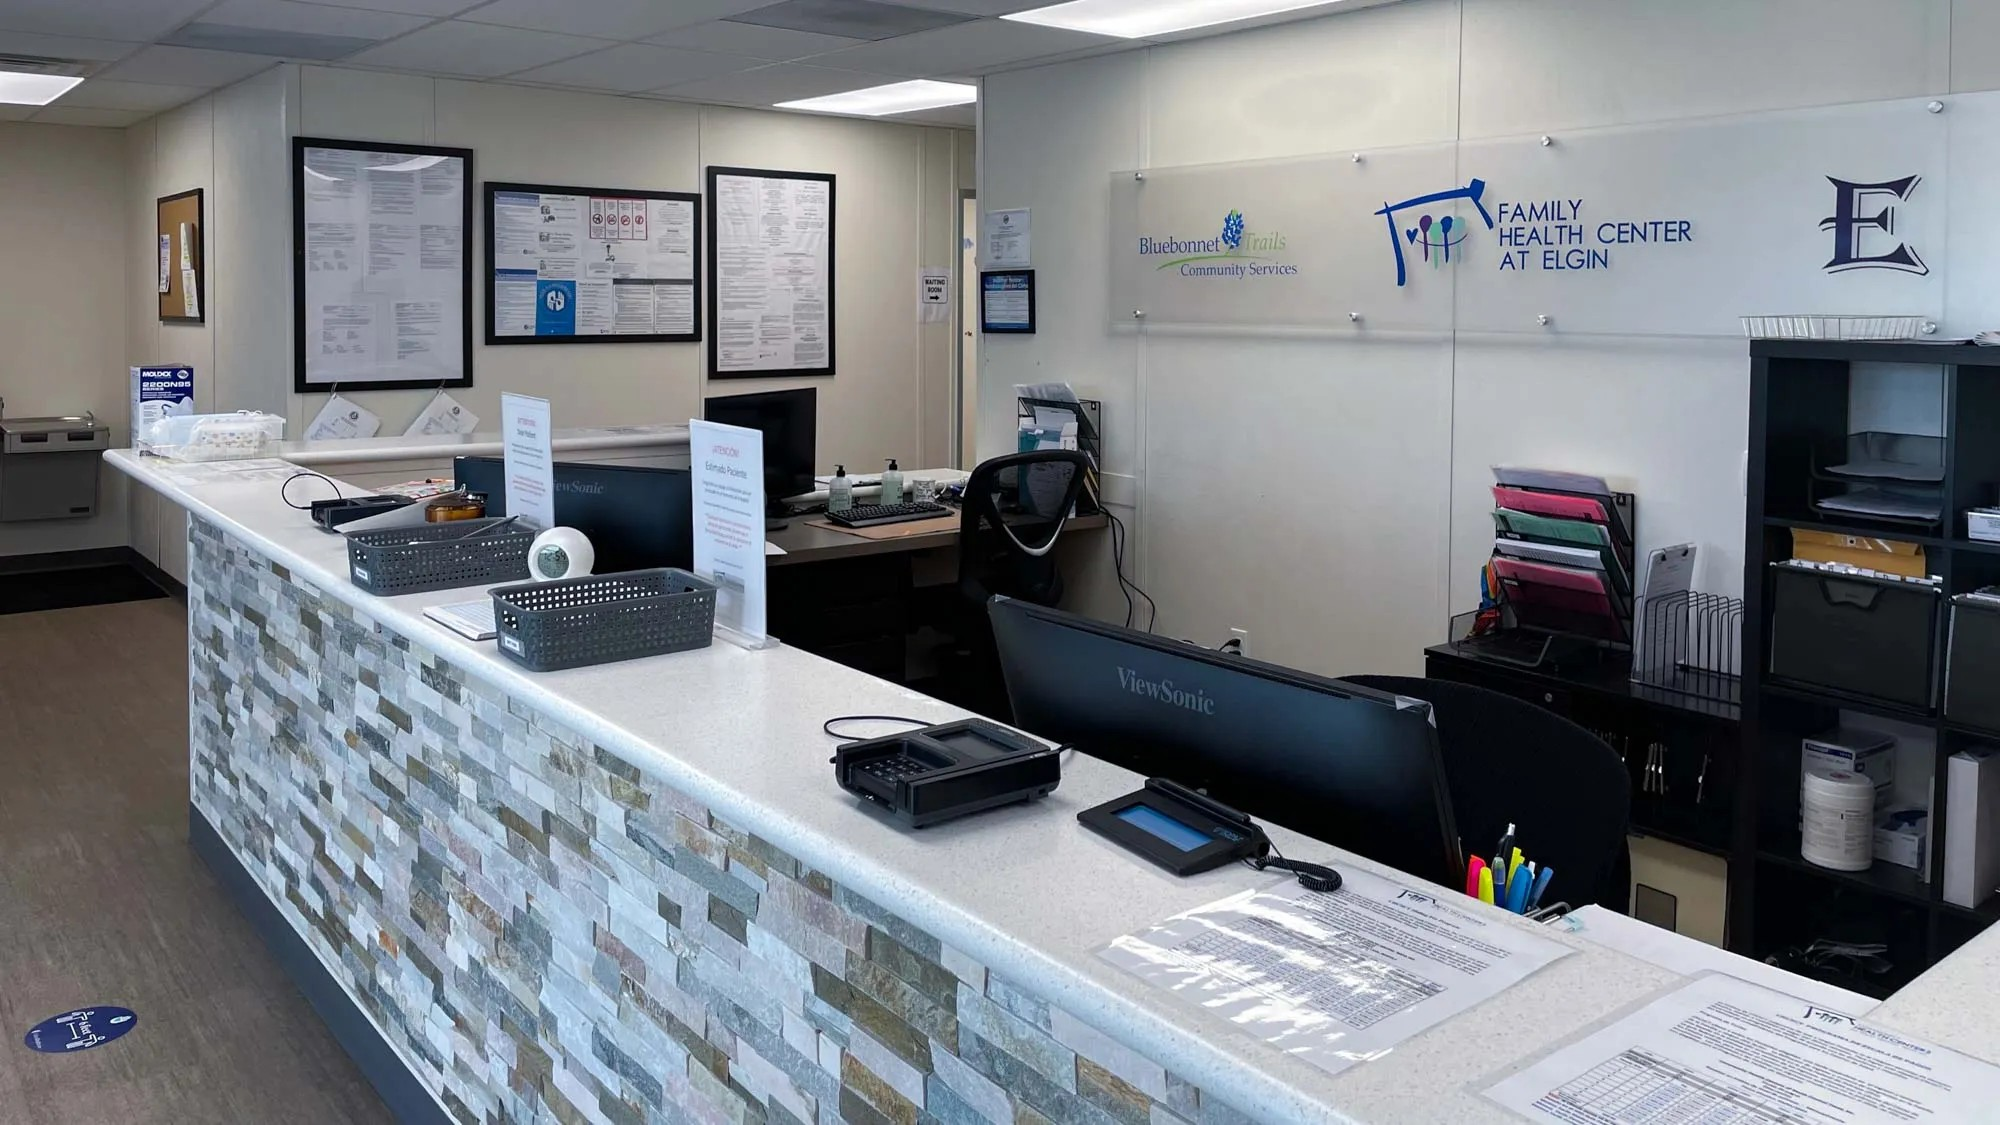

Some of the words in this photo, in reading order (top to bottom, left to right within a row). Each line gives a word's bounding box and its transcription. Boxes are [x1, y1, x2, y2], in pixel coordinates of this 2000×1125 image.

[1498, 199, 1583, 223] FAMILY
[1499, 225, 1583, 247] HEALTH
[1597, 220, 1692, 244] CENTER
[1818, 174, 1929, 276] E
[1139, 236, 1220, 255] Bluebonnet
[1244, 231, 1287, 251] Trails
[1180, 263, 1246, 280] Community
[1249, 262, 1298, 276] Services
[1499, 250, 1530, 270] AT
[1543, 249, 1609, 270] ELGIN
[1116, 665, 1215, 715] ViewSonic
